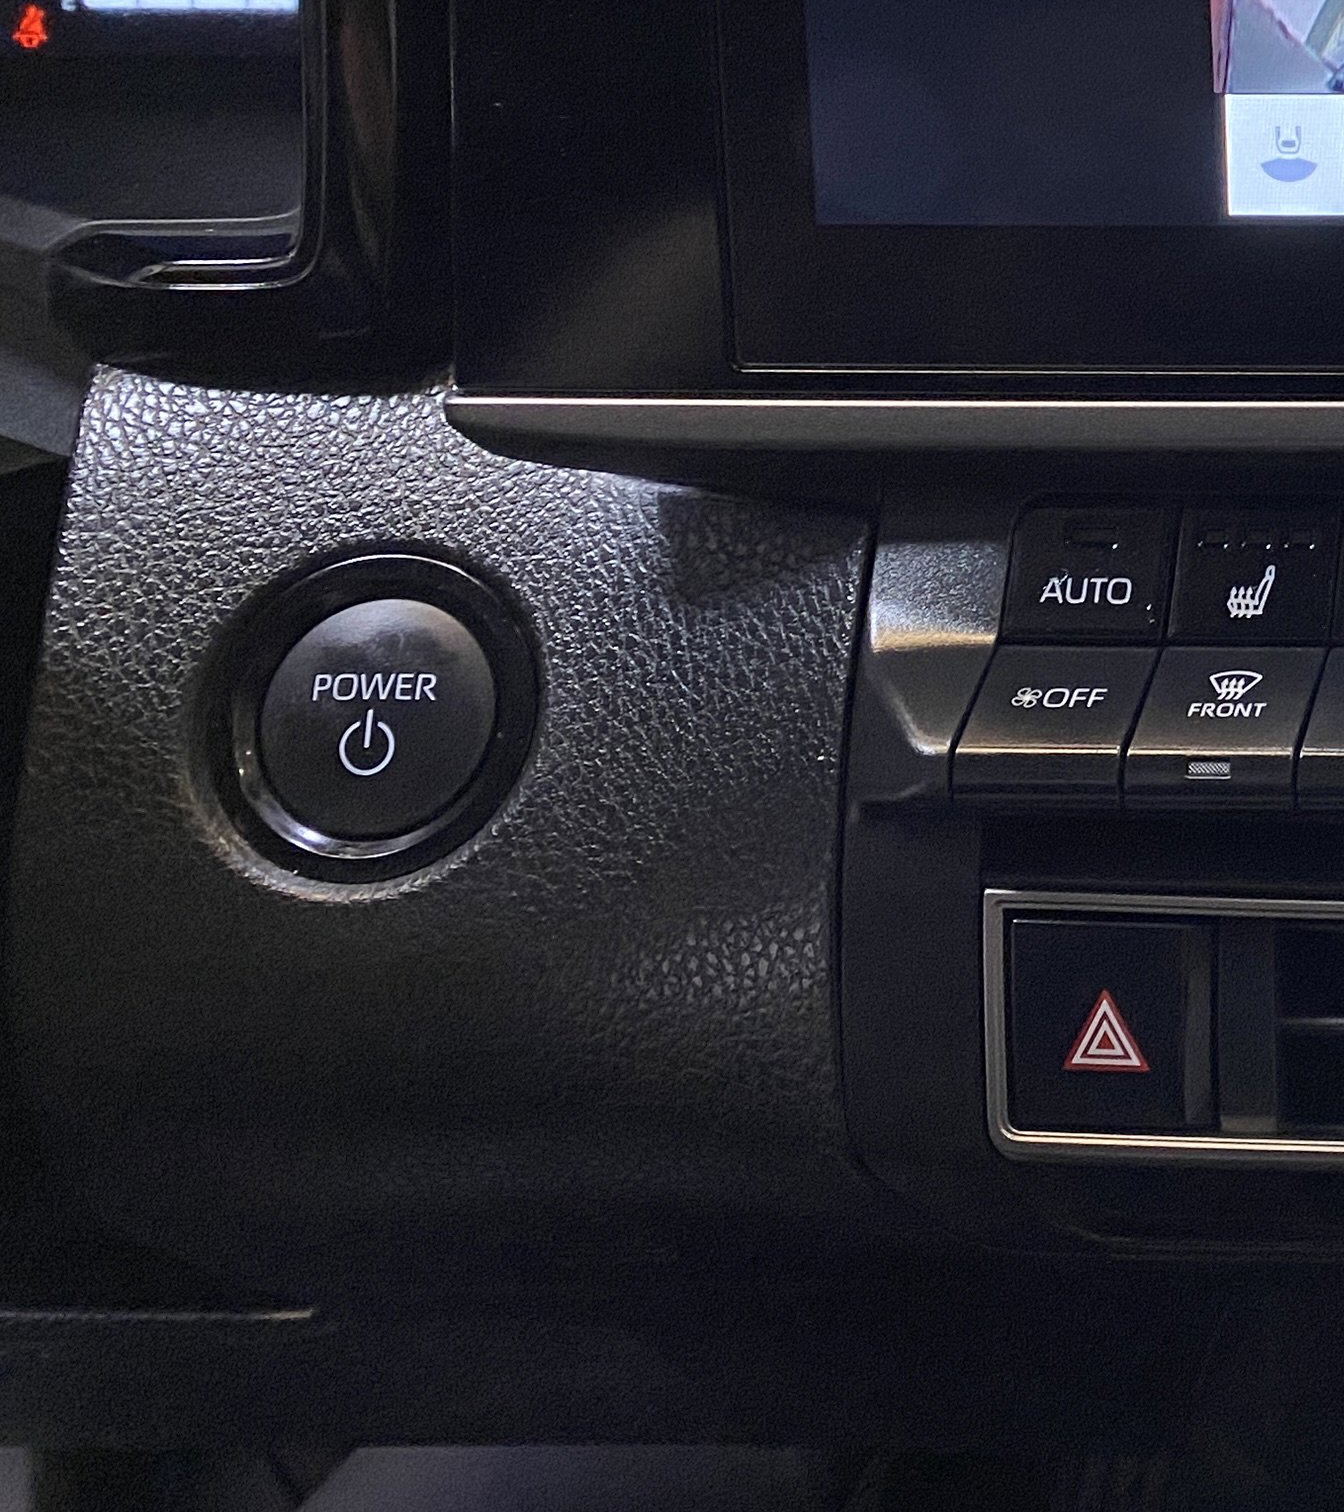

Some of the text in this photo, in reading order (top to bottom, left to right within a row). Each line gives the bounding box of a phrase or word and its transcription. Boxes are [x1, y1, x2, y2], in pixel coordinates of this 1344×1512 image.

[1039, 575, 1133, 606] AUTO
[311, 672, 438, 702] POWER
[1041, 687, 1109, 710] OFF
[1186, 701, 1267, 719] FRONT
